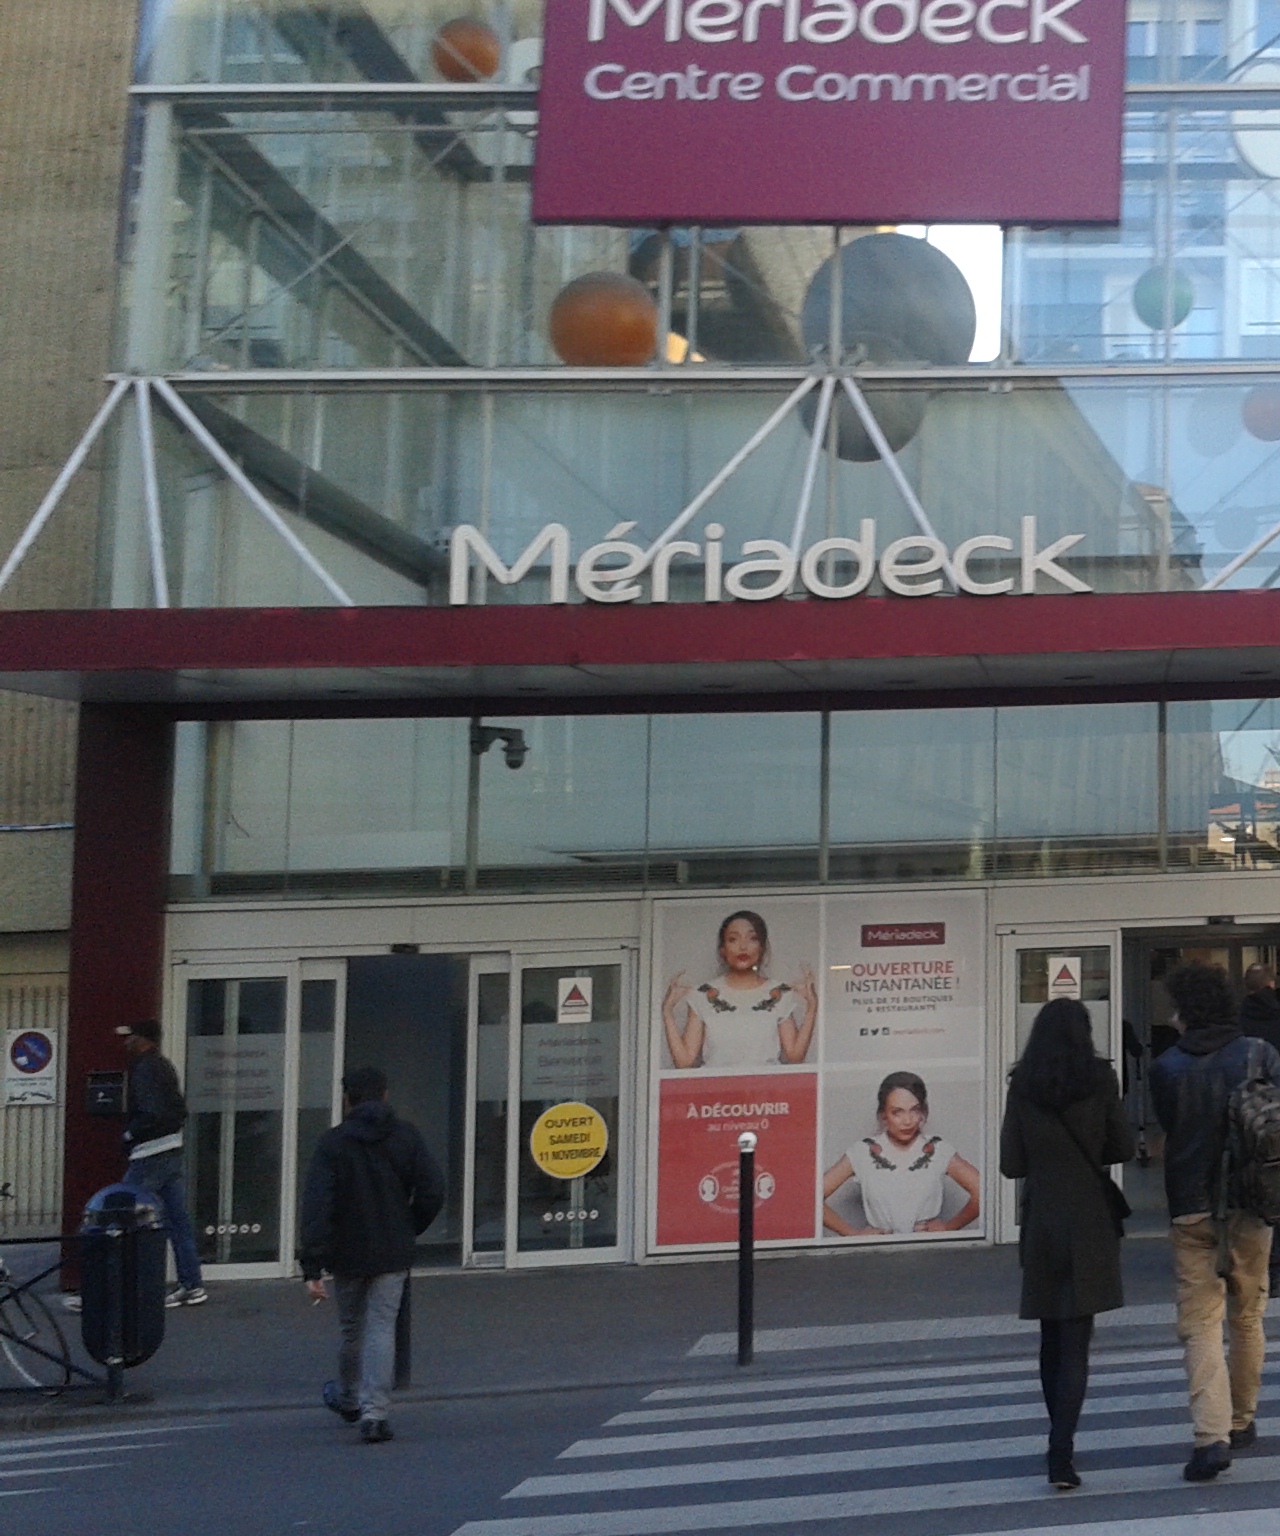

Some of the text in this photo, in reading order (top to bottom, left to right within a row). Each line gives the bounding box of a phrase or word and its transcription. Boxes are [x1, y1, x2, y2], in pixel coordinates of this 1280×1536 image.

[584, 63, 1091, 102] Centre Commercial
[448, 515, 1094, 605] Mériadeck
[852, 960, 955, 977] OUVERTURE
[845, 976, 952, 993] INSTANTANÉE
[686, 1101, 790, 1119] À DÉCOUVRIR
[544, 1115, 595, 1129] OUVERT
[549, 1131, 591, 1146] SAMEDI
[538, 1147, 602, 1162] 11 NOVEMBRE
